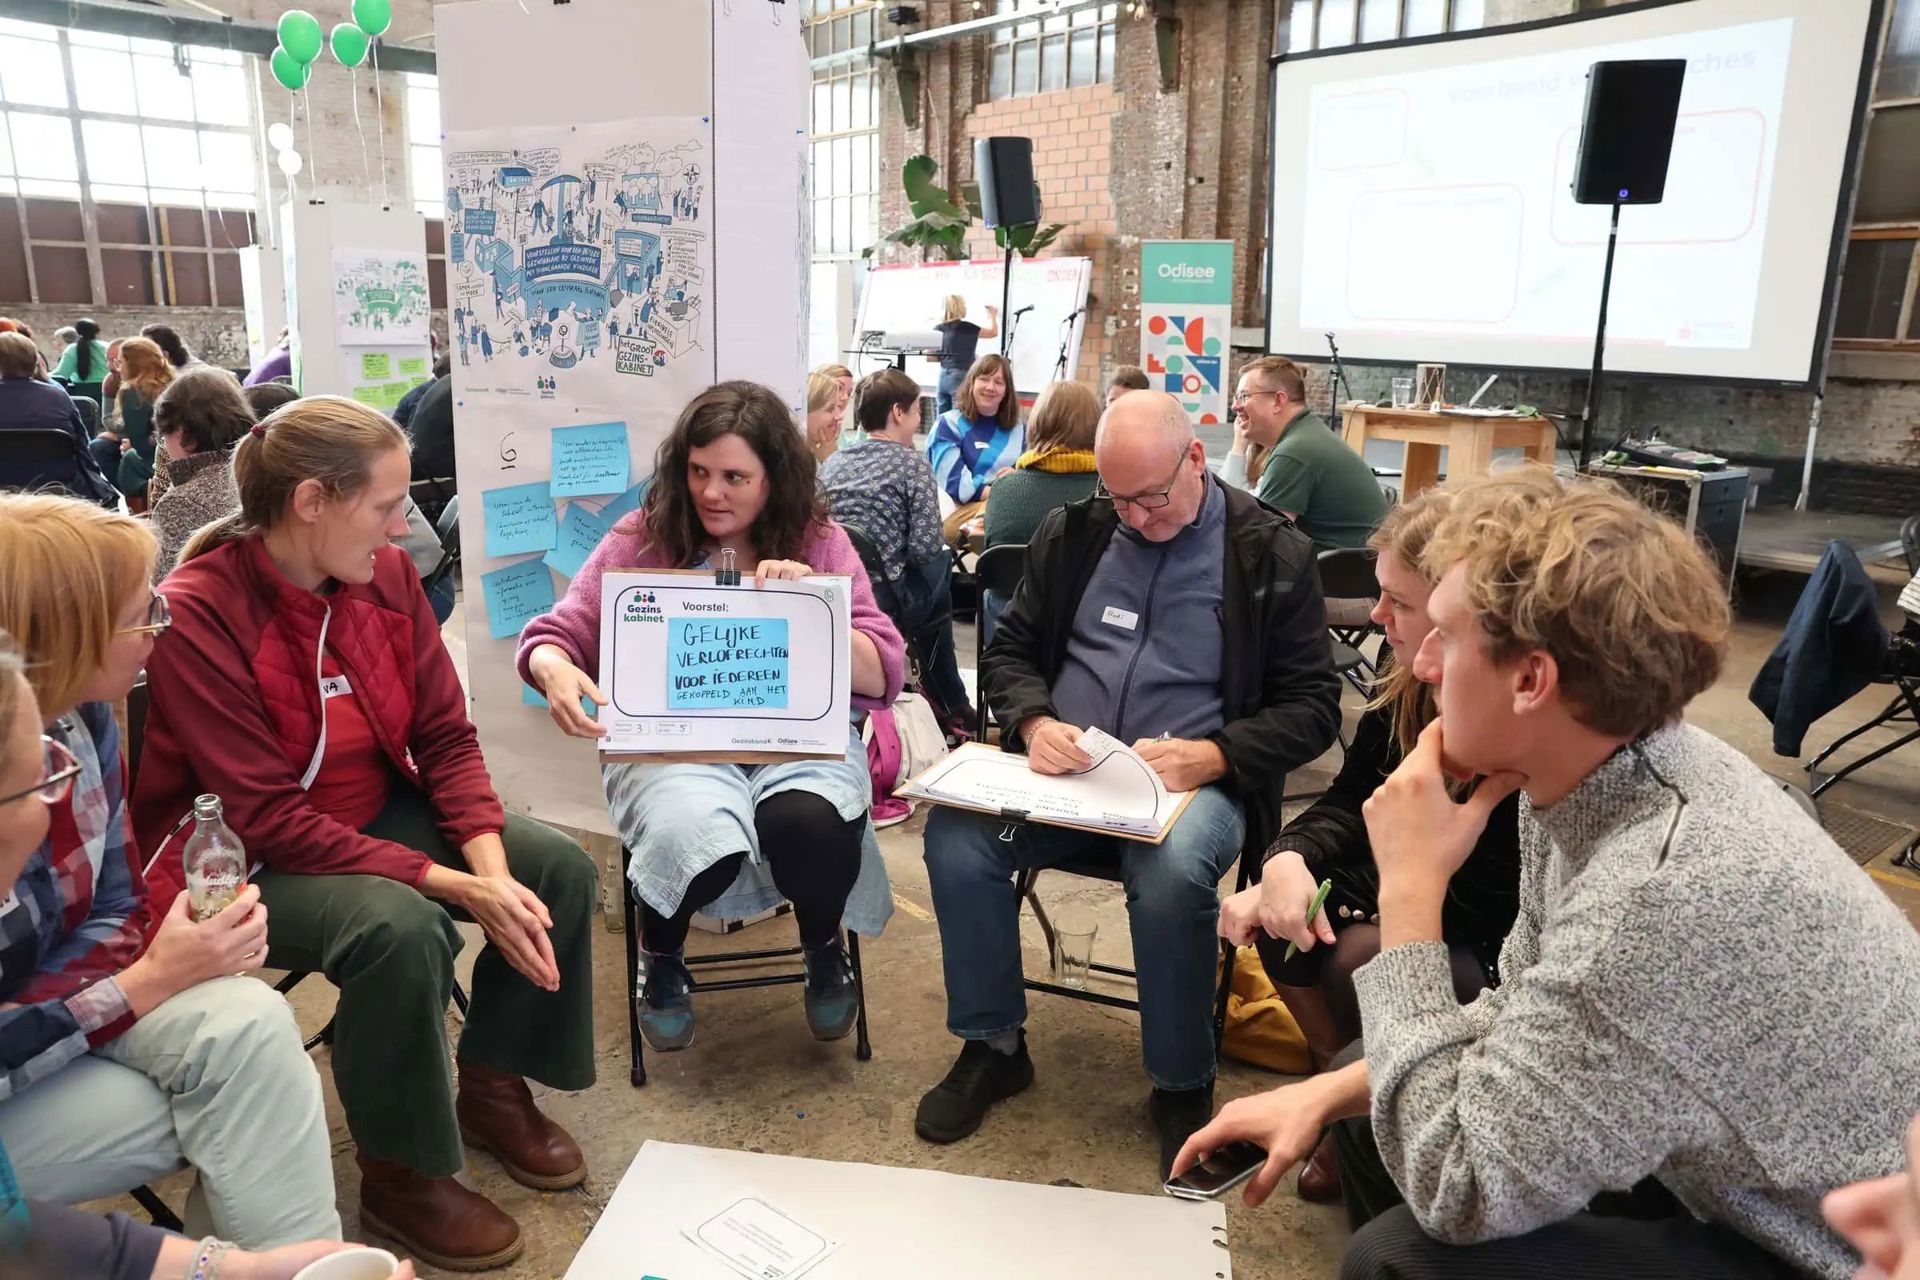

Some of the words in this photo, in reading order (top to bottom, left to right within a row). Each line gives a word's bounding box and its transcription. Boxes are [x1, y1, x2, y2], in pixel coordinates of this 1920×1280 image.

[1158, 263, 1215, 278] Odisee
[620, 339, 630, 348] het
[630, 343, 655, 355] GROOT
[618, 352, 648, 363] GEZINS-
[618, 361, 653, 375] KABINET
[627, 604, 662, 614] Gezins
[683, 601, 729, 612] Voorstel:
[624, 614, 664, 623] kabinet
[677, 648, 788, 667] VERLOFRECHTEN
[675, 674, 706, 690] VOOR
[677, 689, 730, 700] GEKOPPELD
[740, 686, 757, 697] AAN
[767, 685, 786, 695] HET
[733, 695, 766, 705] KIND
[637, 724, 643, 733] 3
[680, 724, 687, 733] 5
